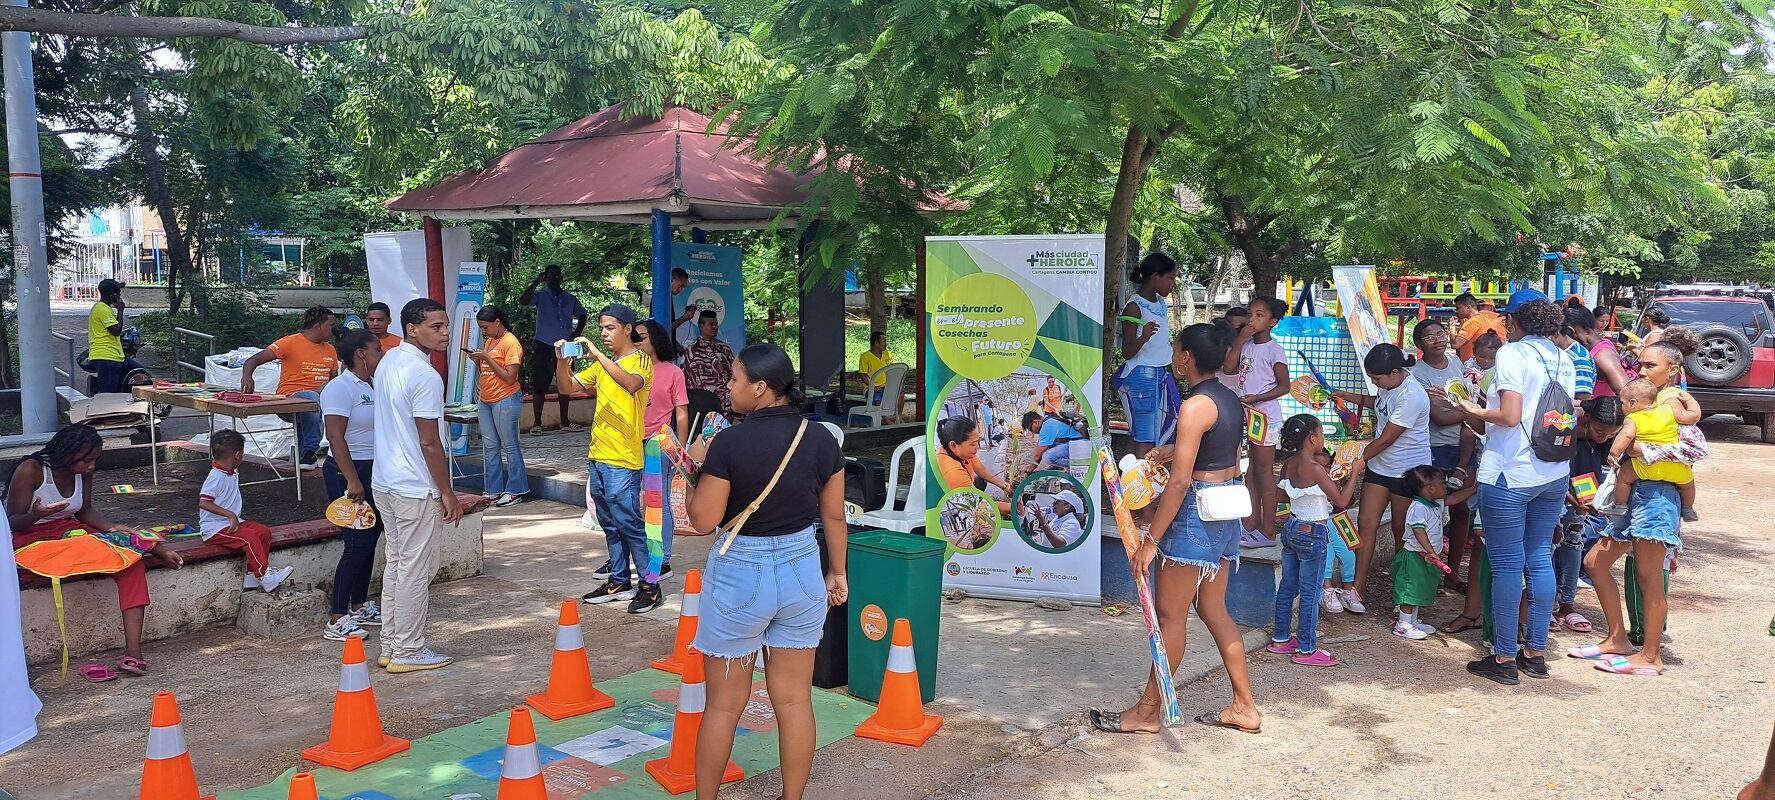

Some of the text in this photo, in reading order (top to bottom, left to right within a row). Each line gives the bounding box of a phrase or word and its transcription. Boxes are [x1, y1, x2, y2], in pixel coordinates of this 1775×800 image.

[1036, 250, 1089, 258] Más ciudad
[1040, 258, 1095, 267] HEROICA
[937, 304, 1003, 313] Sembrando
[963, 315, 1025, 329] presente
[938, 329, 988, 338] Cosechas
[971, 338, 1022, 352] Futuro
[1049, 572, 1078, 581] Encausa
